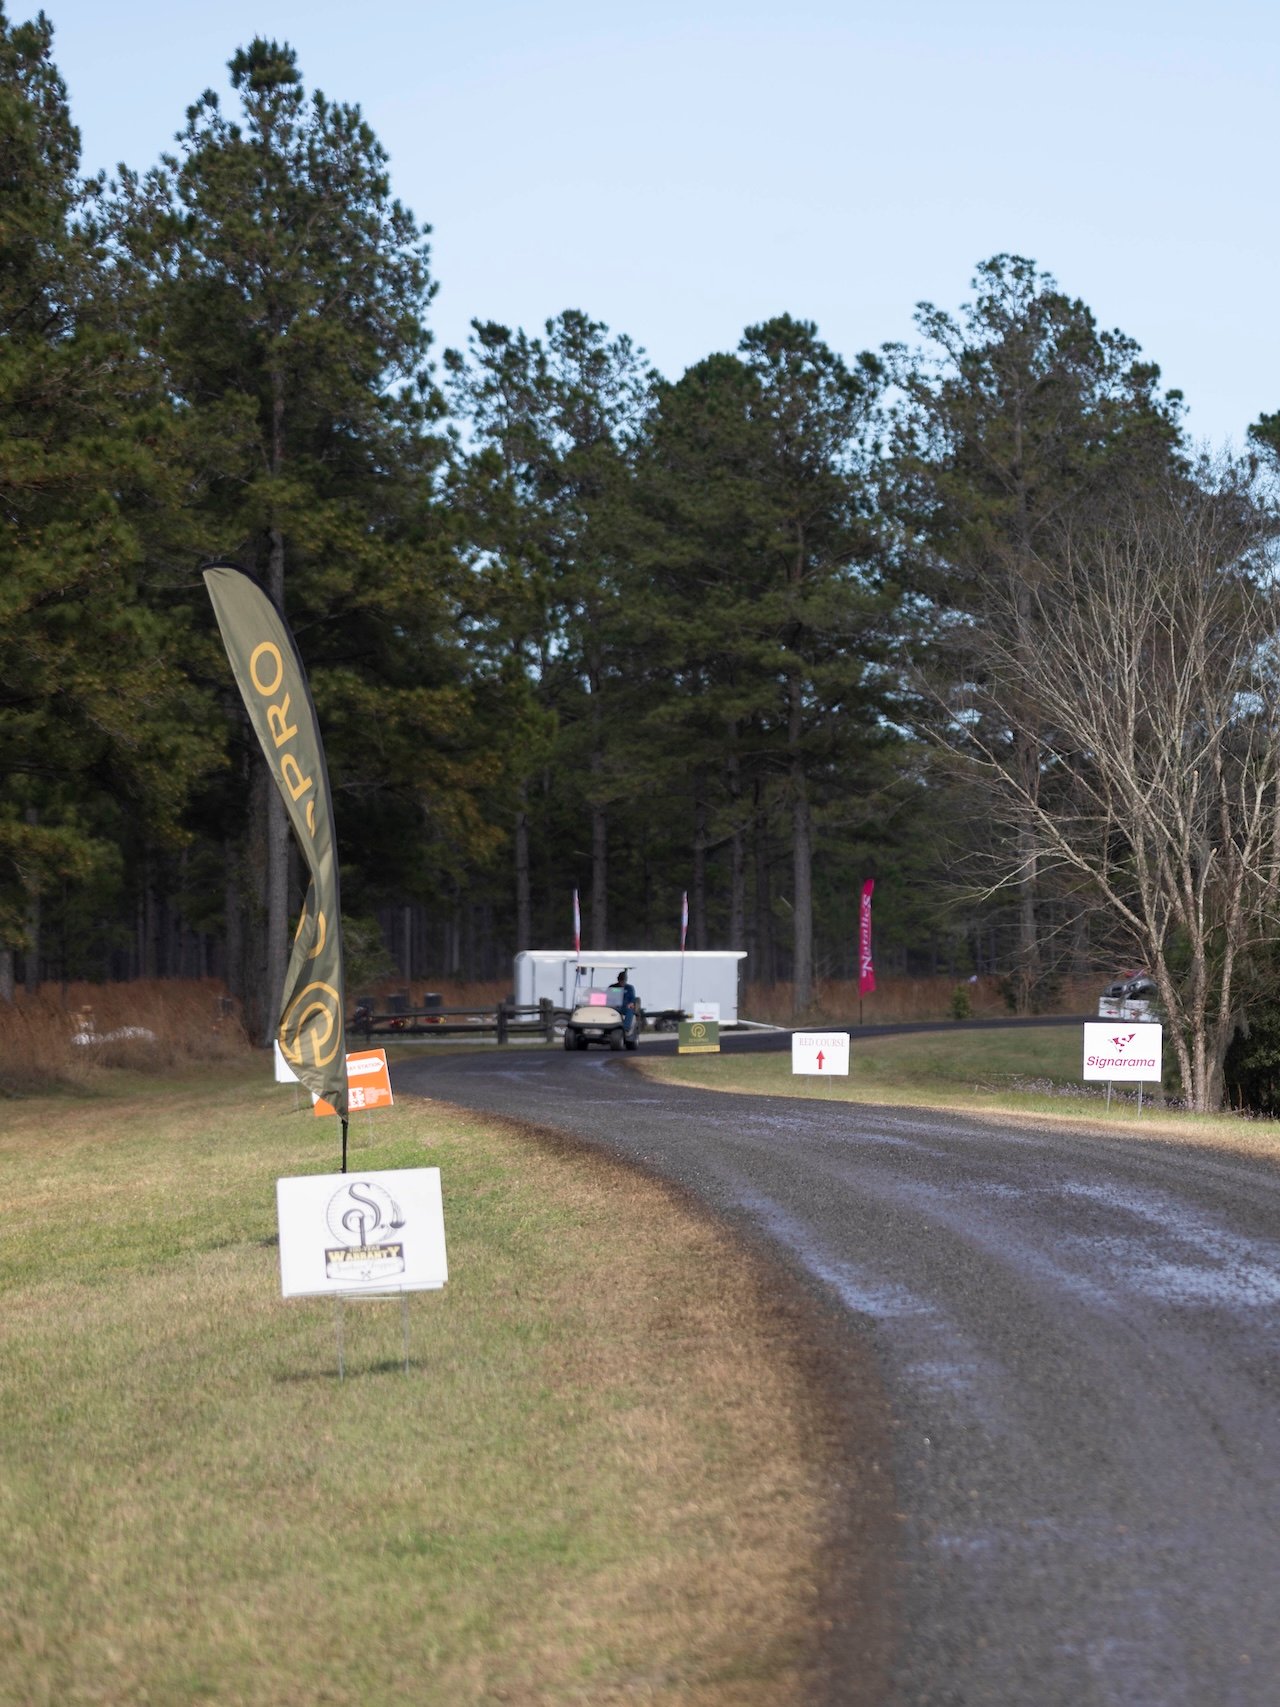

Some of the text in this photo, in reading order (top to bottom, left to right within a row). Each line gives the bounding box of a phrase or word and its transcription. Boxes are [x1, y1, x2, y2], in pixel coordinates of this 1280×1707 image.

[799, 1037, 846, 1048] RED COURSE
[1086, 1055, 1156, 1069] Signarama
[328, 1246, 400, 1263] WARRANTY
